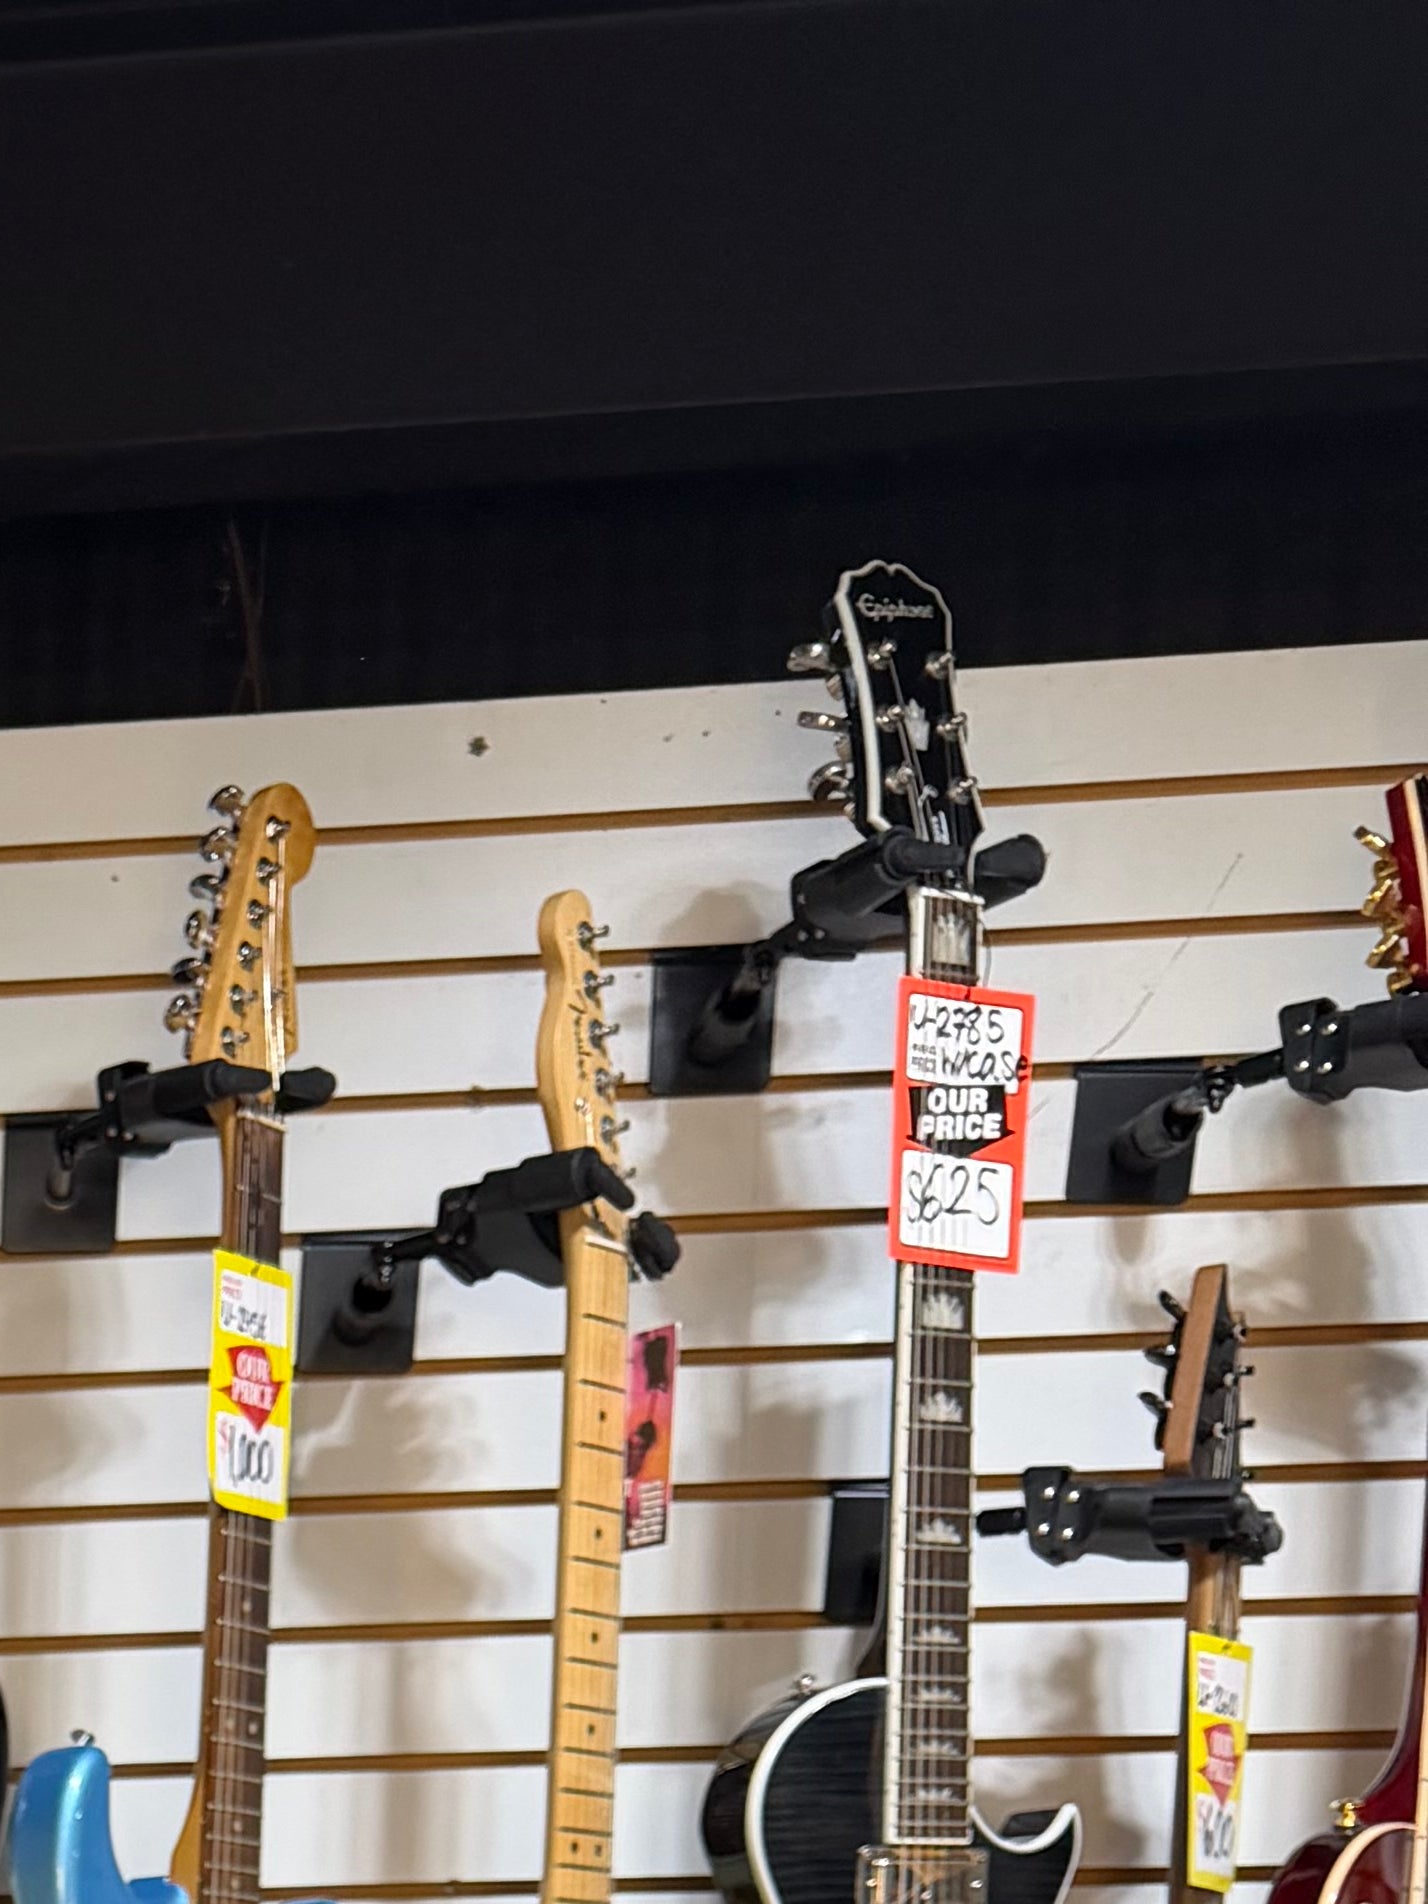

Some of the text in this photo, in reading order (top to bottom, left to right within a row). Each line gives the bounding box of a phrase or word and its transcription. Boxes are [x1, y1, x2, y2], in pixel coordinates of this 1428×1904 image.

[927, 1087, 990, 1114] OUR
[918, 1112, 1003, 1142] PRICE
[906, 1163, 1001, 1226] $625
[235, 1351, 272, 1381] OUR
[230, 1375, 274, 1412] PRICE
